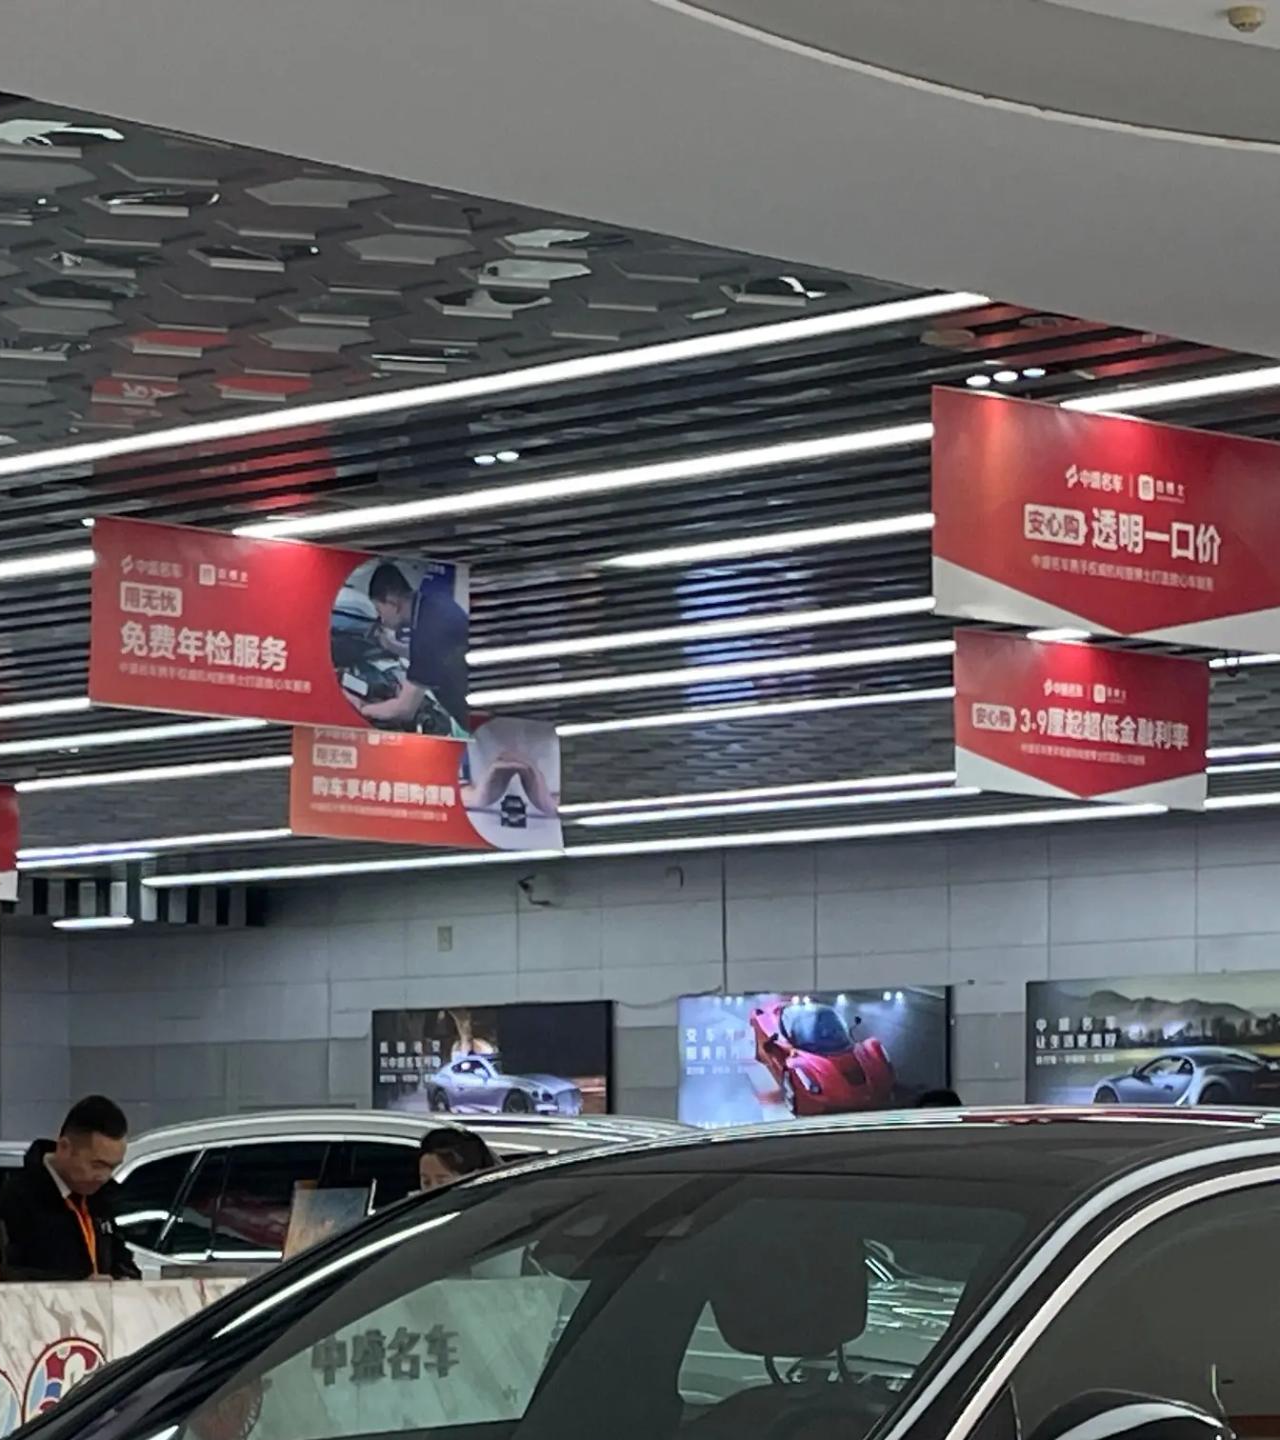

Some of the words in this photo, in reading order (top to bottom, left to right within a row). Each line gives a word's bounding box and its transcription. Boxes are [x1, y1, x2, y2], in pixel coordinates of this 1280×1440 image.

[1028, 510, 1080, 541] 安心购
[1092, 506, 1220, 566] 透明一口价
[124, 586, 177, 614] 用无忧
[121, 620, 288, 672] 免费年检服务
[1020, 706, 1189, 750] 3.9厘起超低金融利率
[311, 1324, 459, 1387] 中盛名车
